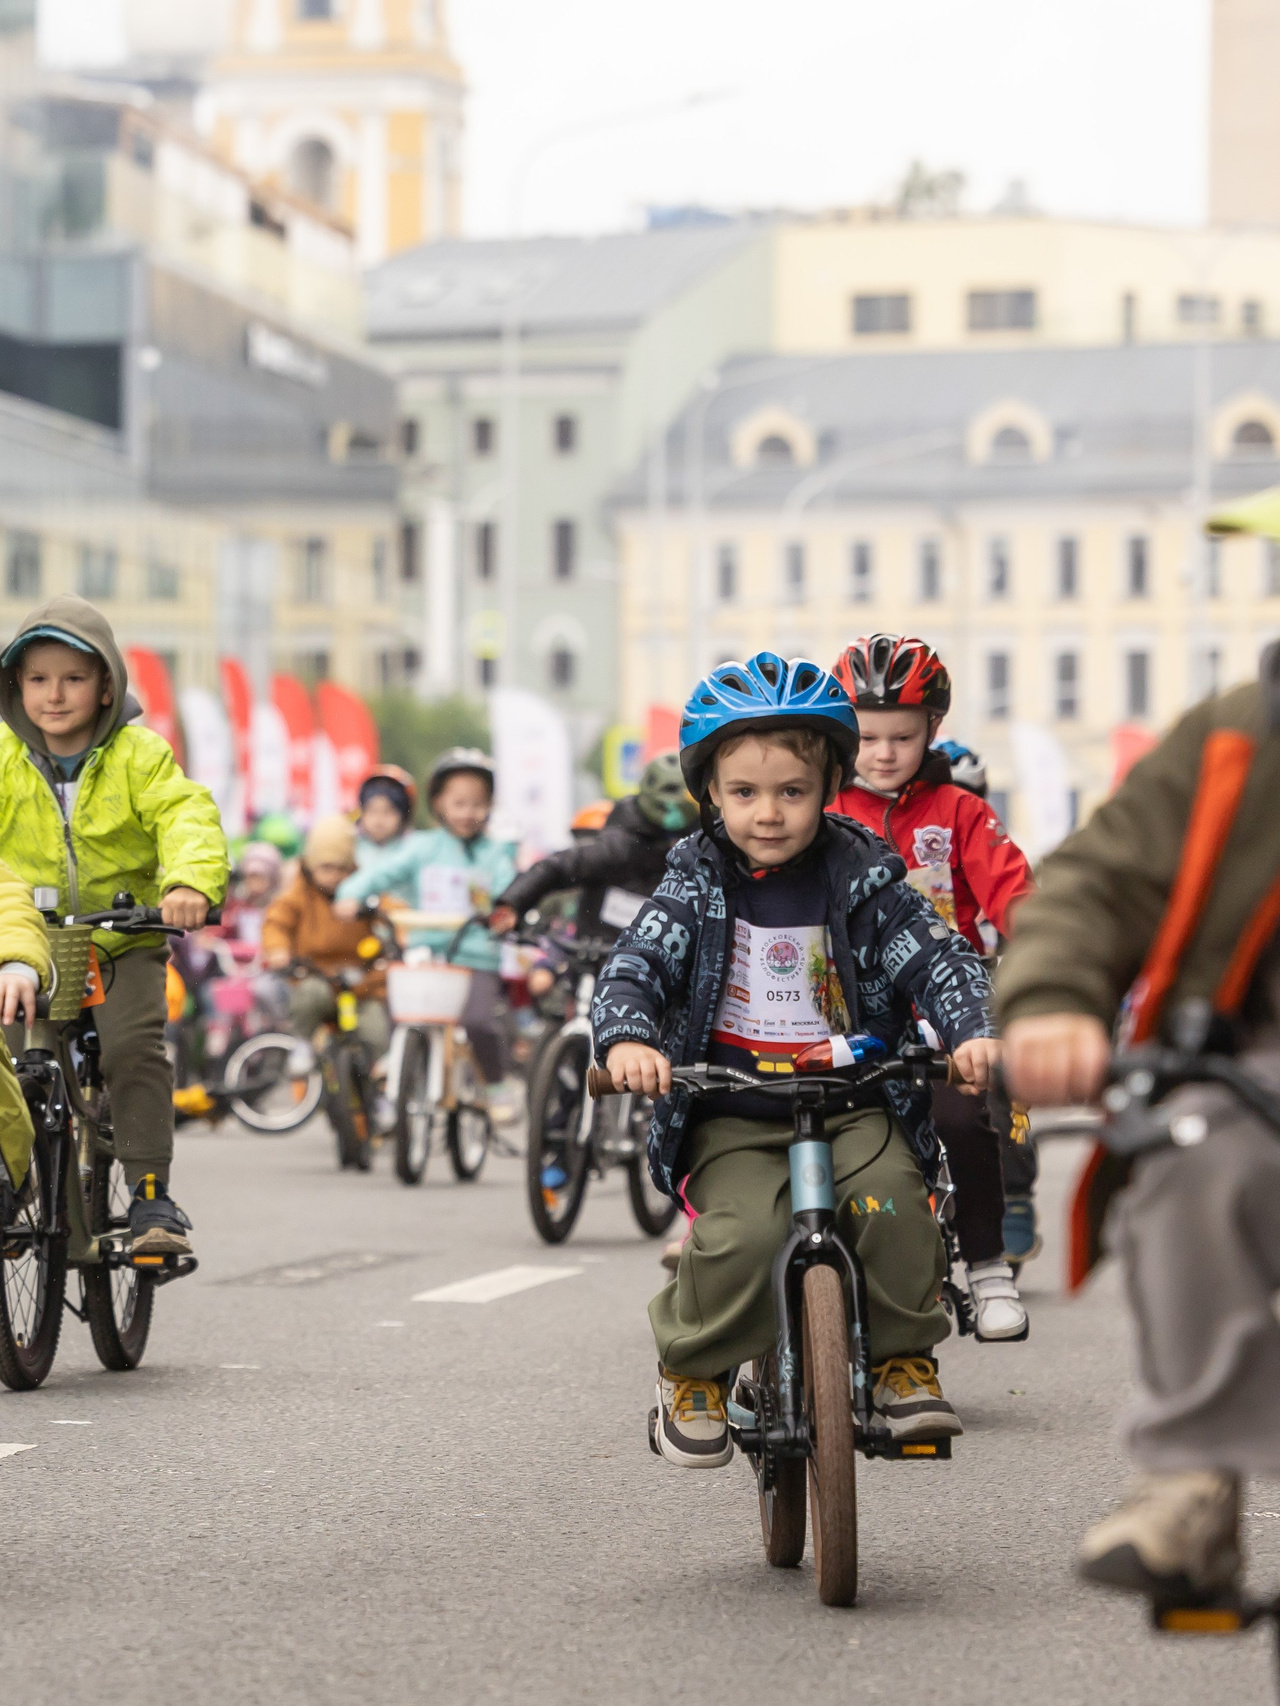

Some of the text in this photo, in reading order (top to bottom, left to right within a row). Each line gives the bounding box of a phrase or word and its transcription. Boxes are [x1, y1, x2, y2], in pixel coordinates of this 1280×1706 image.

[637, 909, 691, 960] 68
[766, 990, 800, 1002] 0573
[598, 1023, 650, 1042] OCEANS
